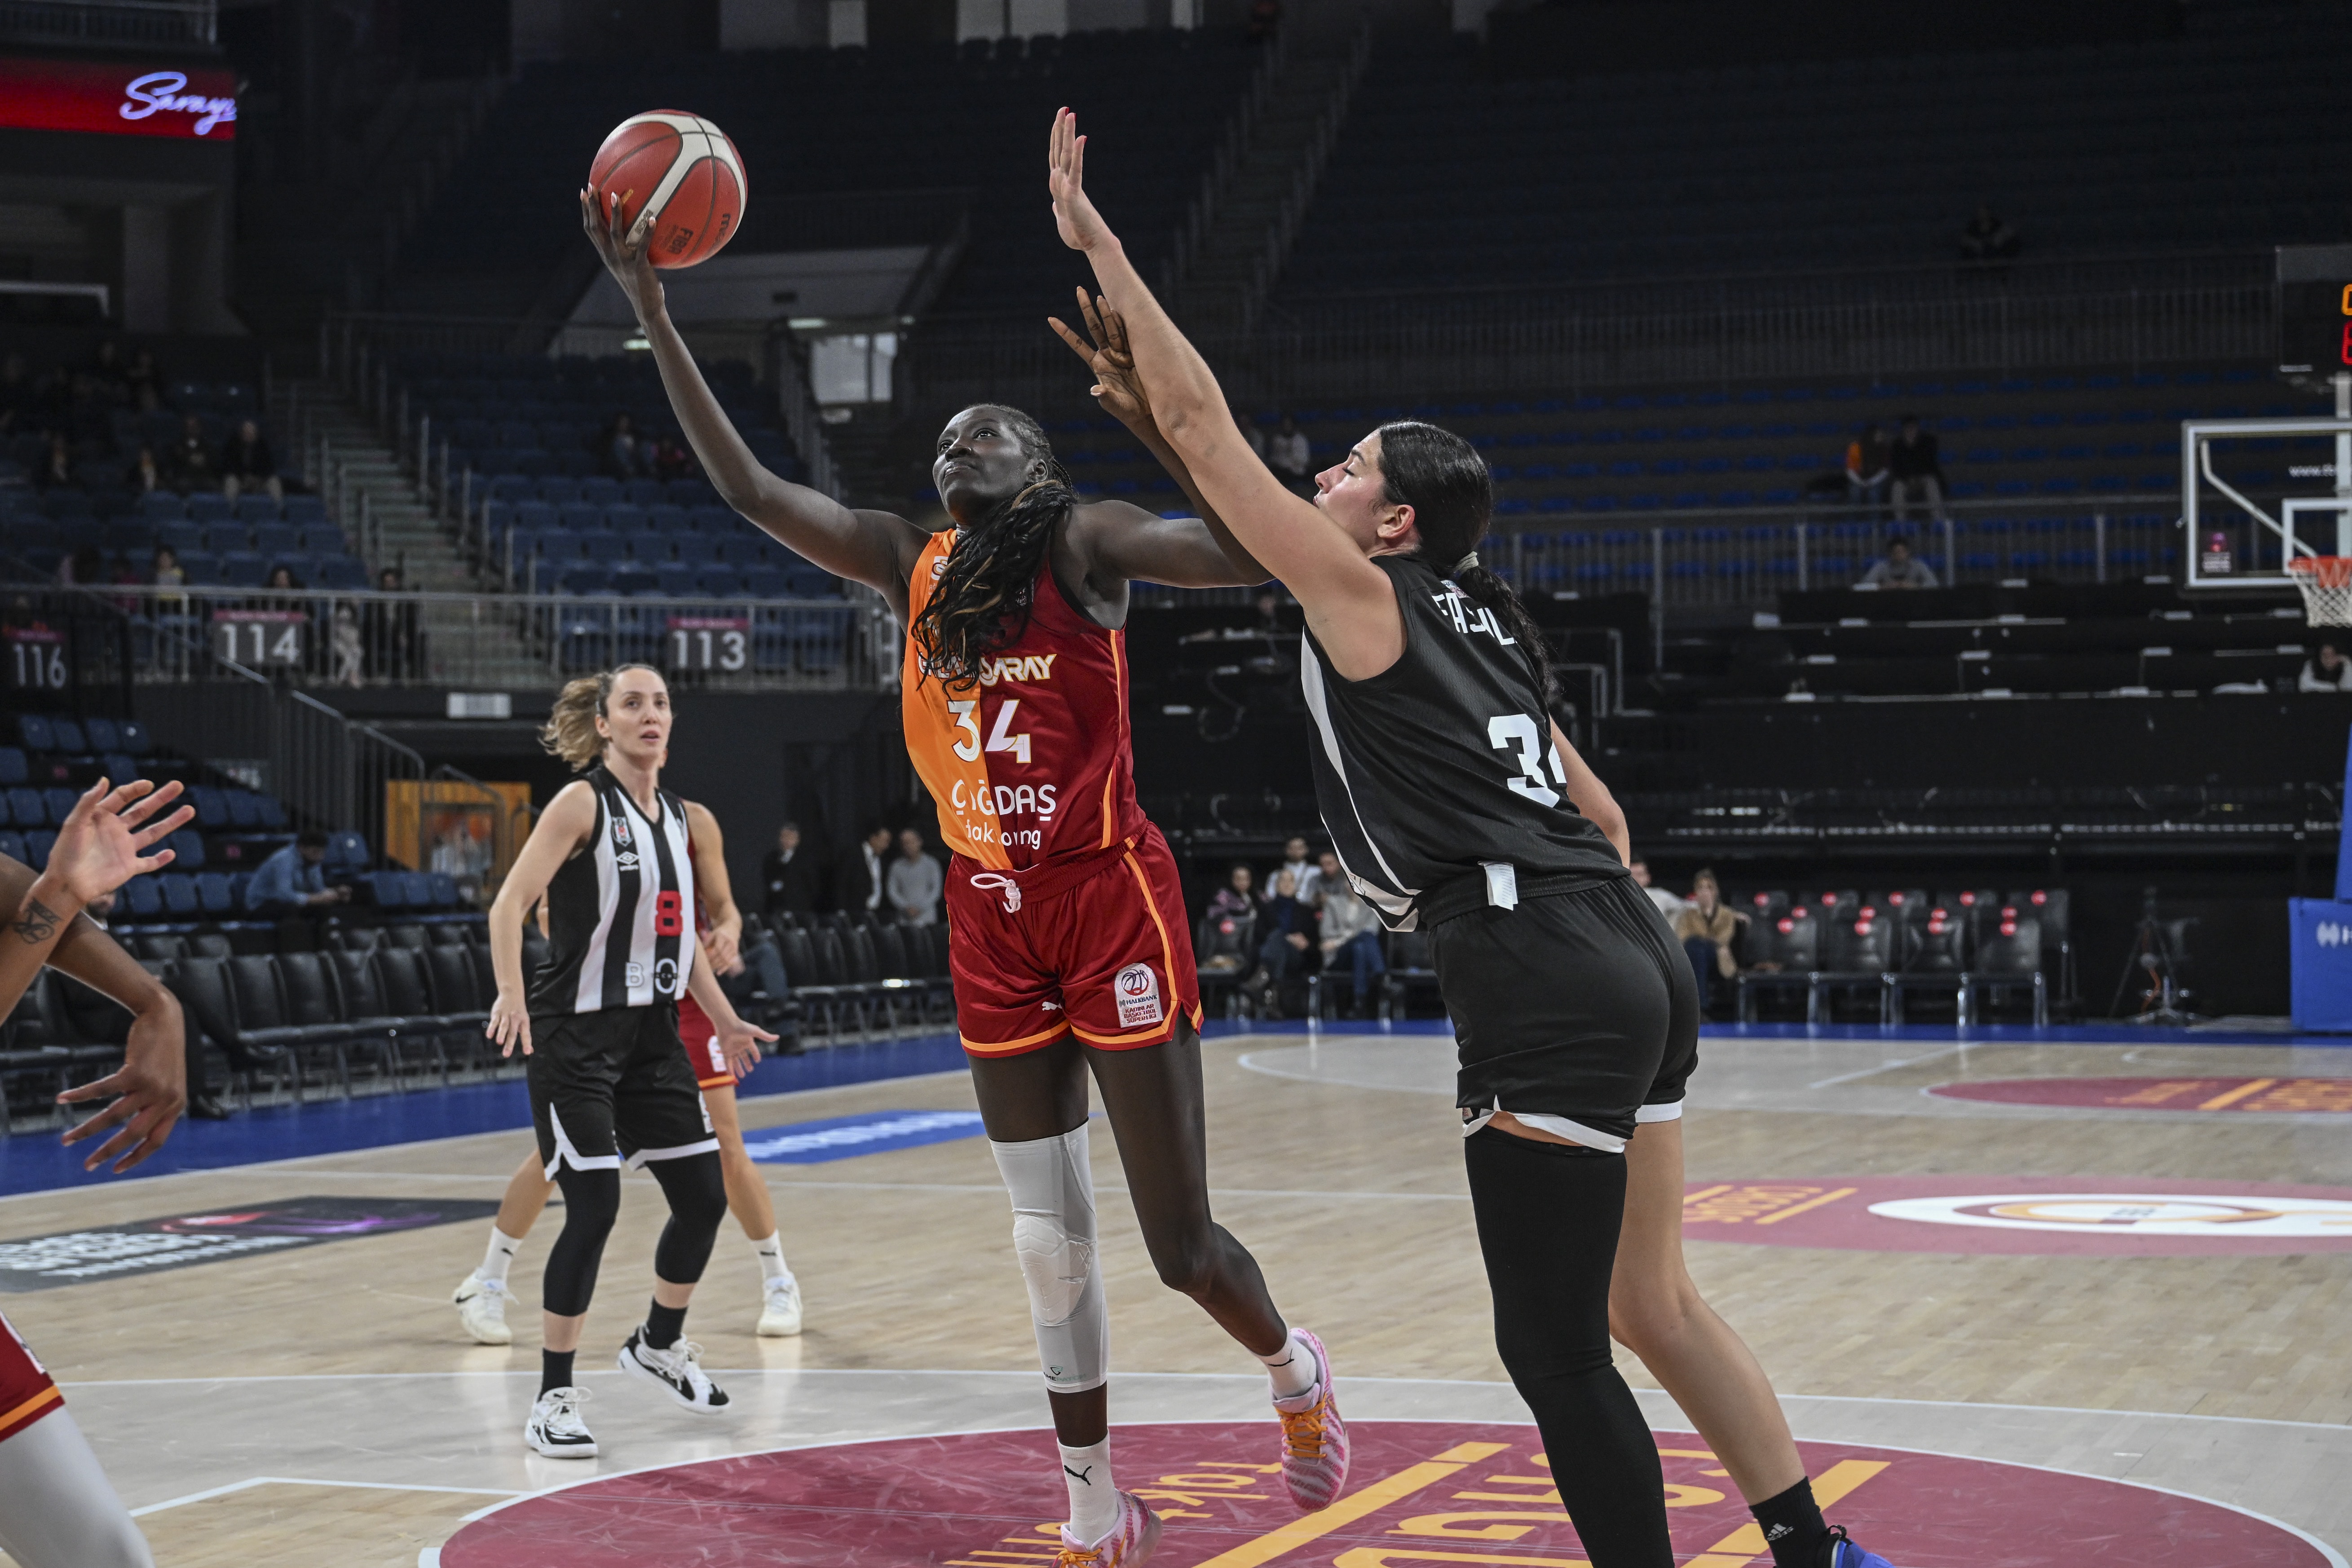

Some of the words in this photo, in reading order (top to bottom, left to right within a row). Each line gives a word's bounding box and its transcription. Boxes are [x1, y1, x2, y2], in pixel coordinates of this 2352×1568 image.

[221, 623, 300, 663] 114
[673, 630, 746, 670] 113
[13, 643, 66, 689] 116
[947, 699, 1032, 764] 34
[951, 779, 1057, 822] ÇĞDAŞ
[655, 890, 683, 936] 8
[1124, 1009, 1157, 1018] BASKETBOL
[1125, 1004, 1154, 1013] KADINLAR
[1126, 995, 1157, 1005] HALKBANK
